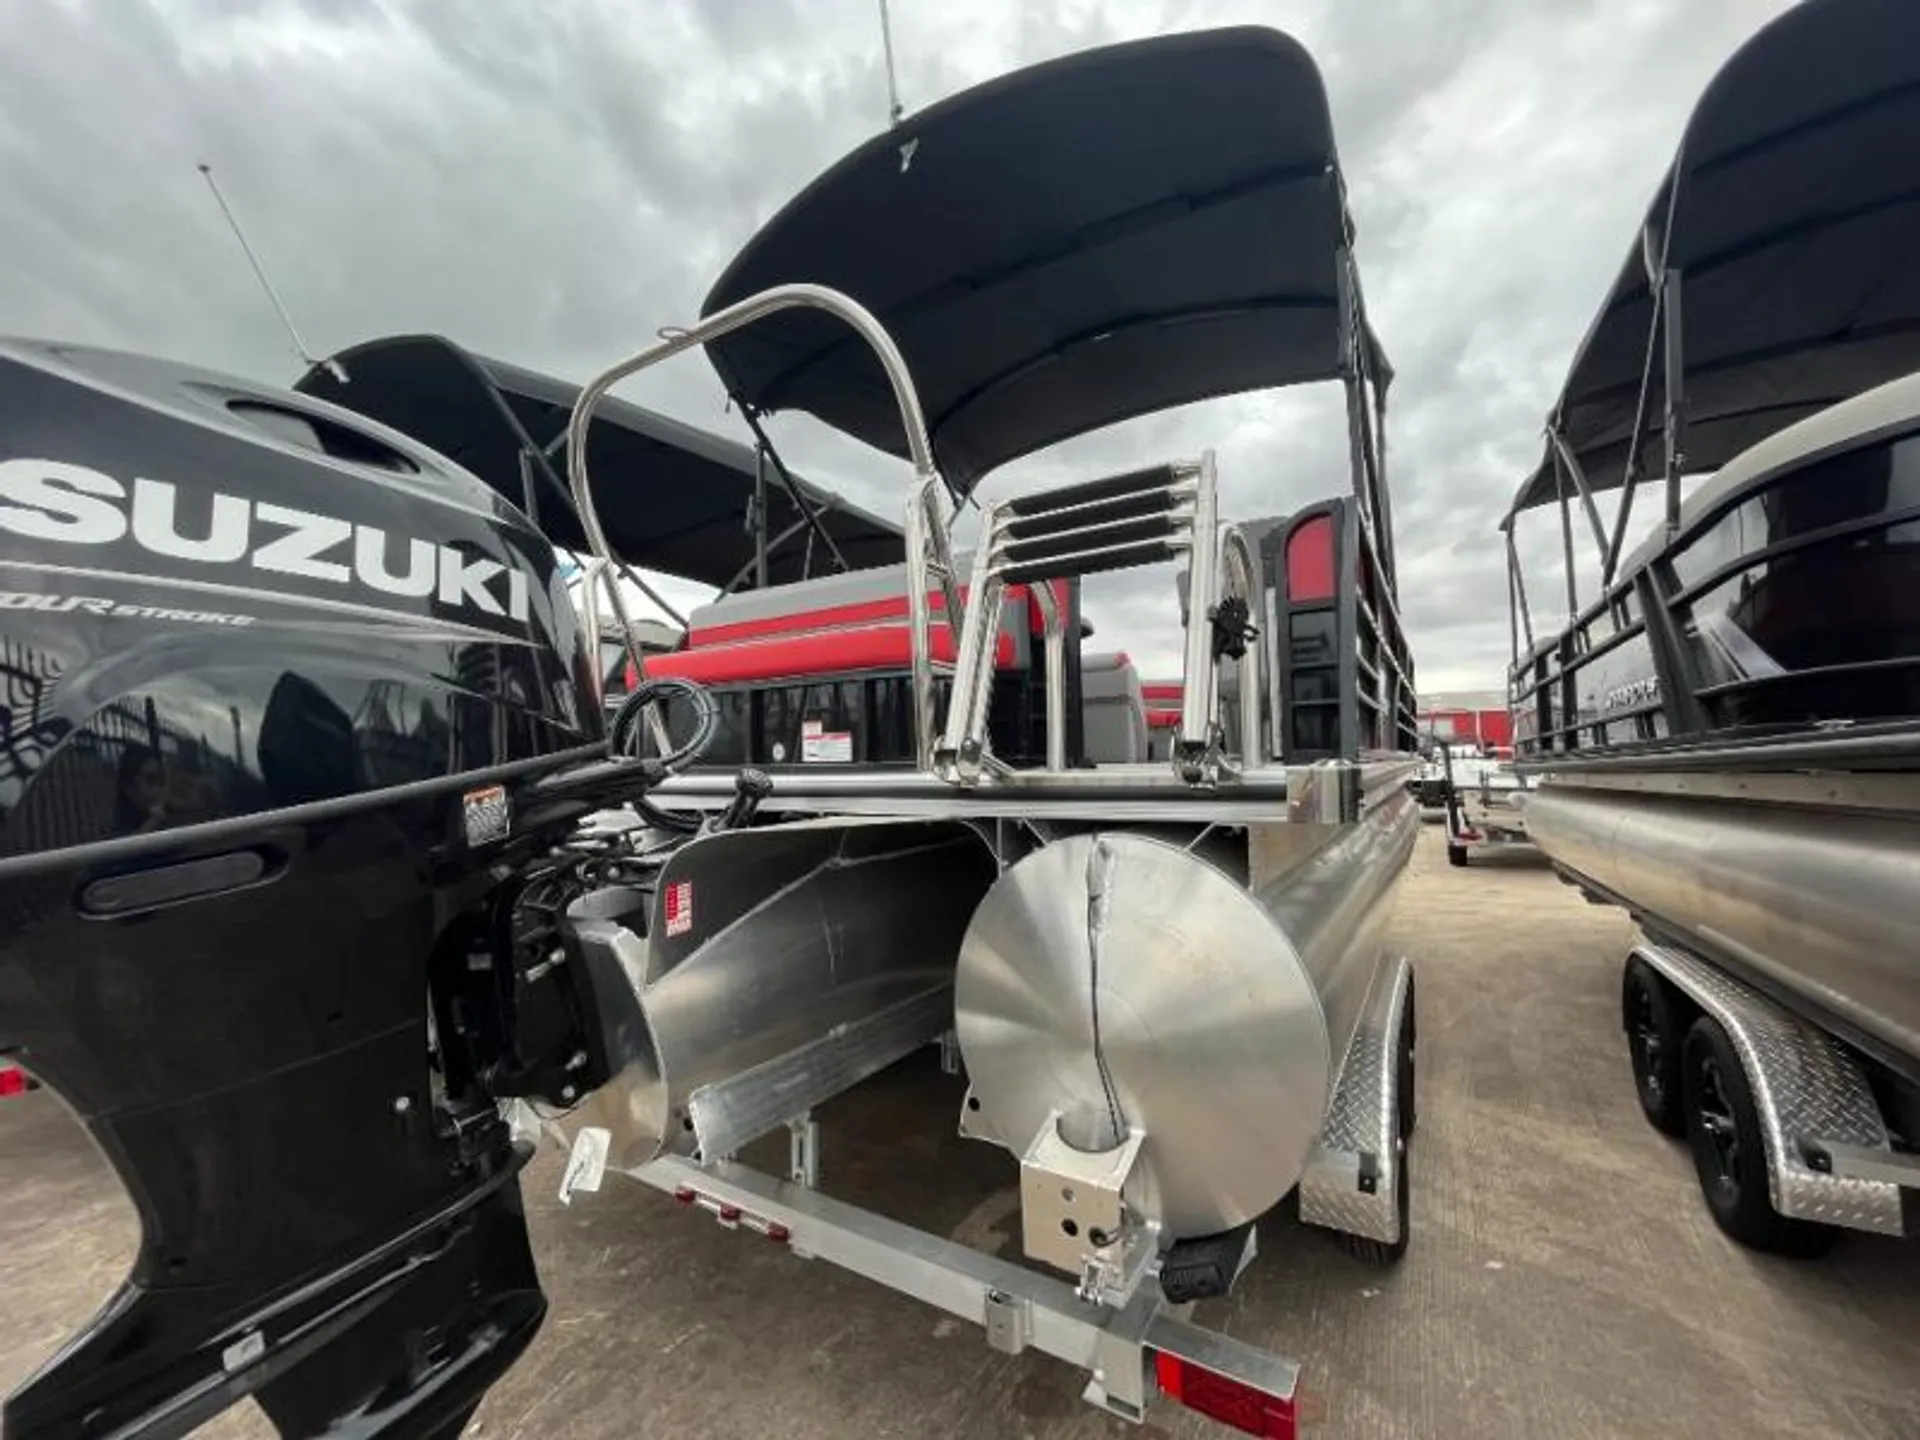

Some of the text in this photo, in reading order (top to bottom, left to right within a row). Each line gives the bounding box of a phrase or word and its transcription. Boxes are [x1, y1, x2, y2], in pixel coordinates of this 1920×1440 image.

[0, 458, 528, 621] SUZUKI
[0, 592, 256, 626] OUR STROKE
